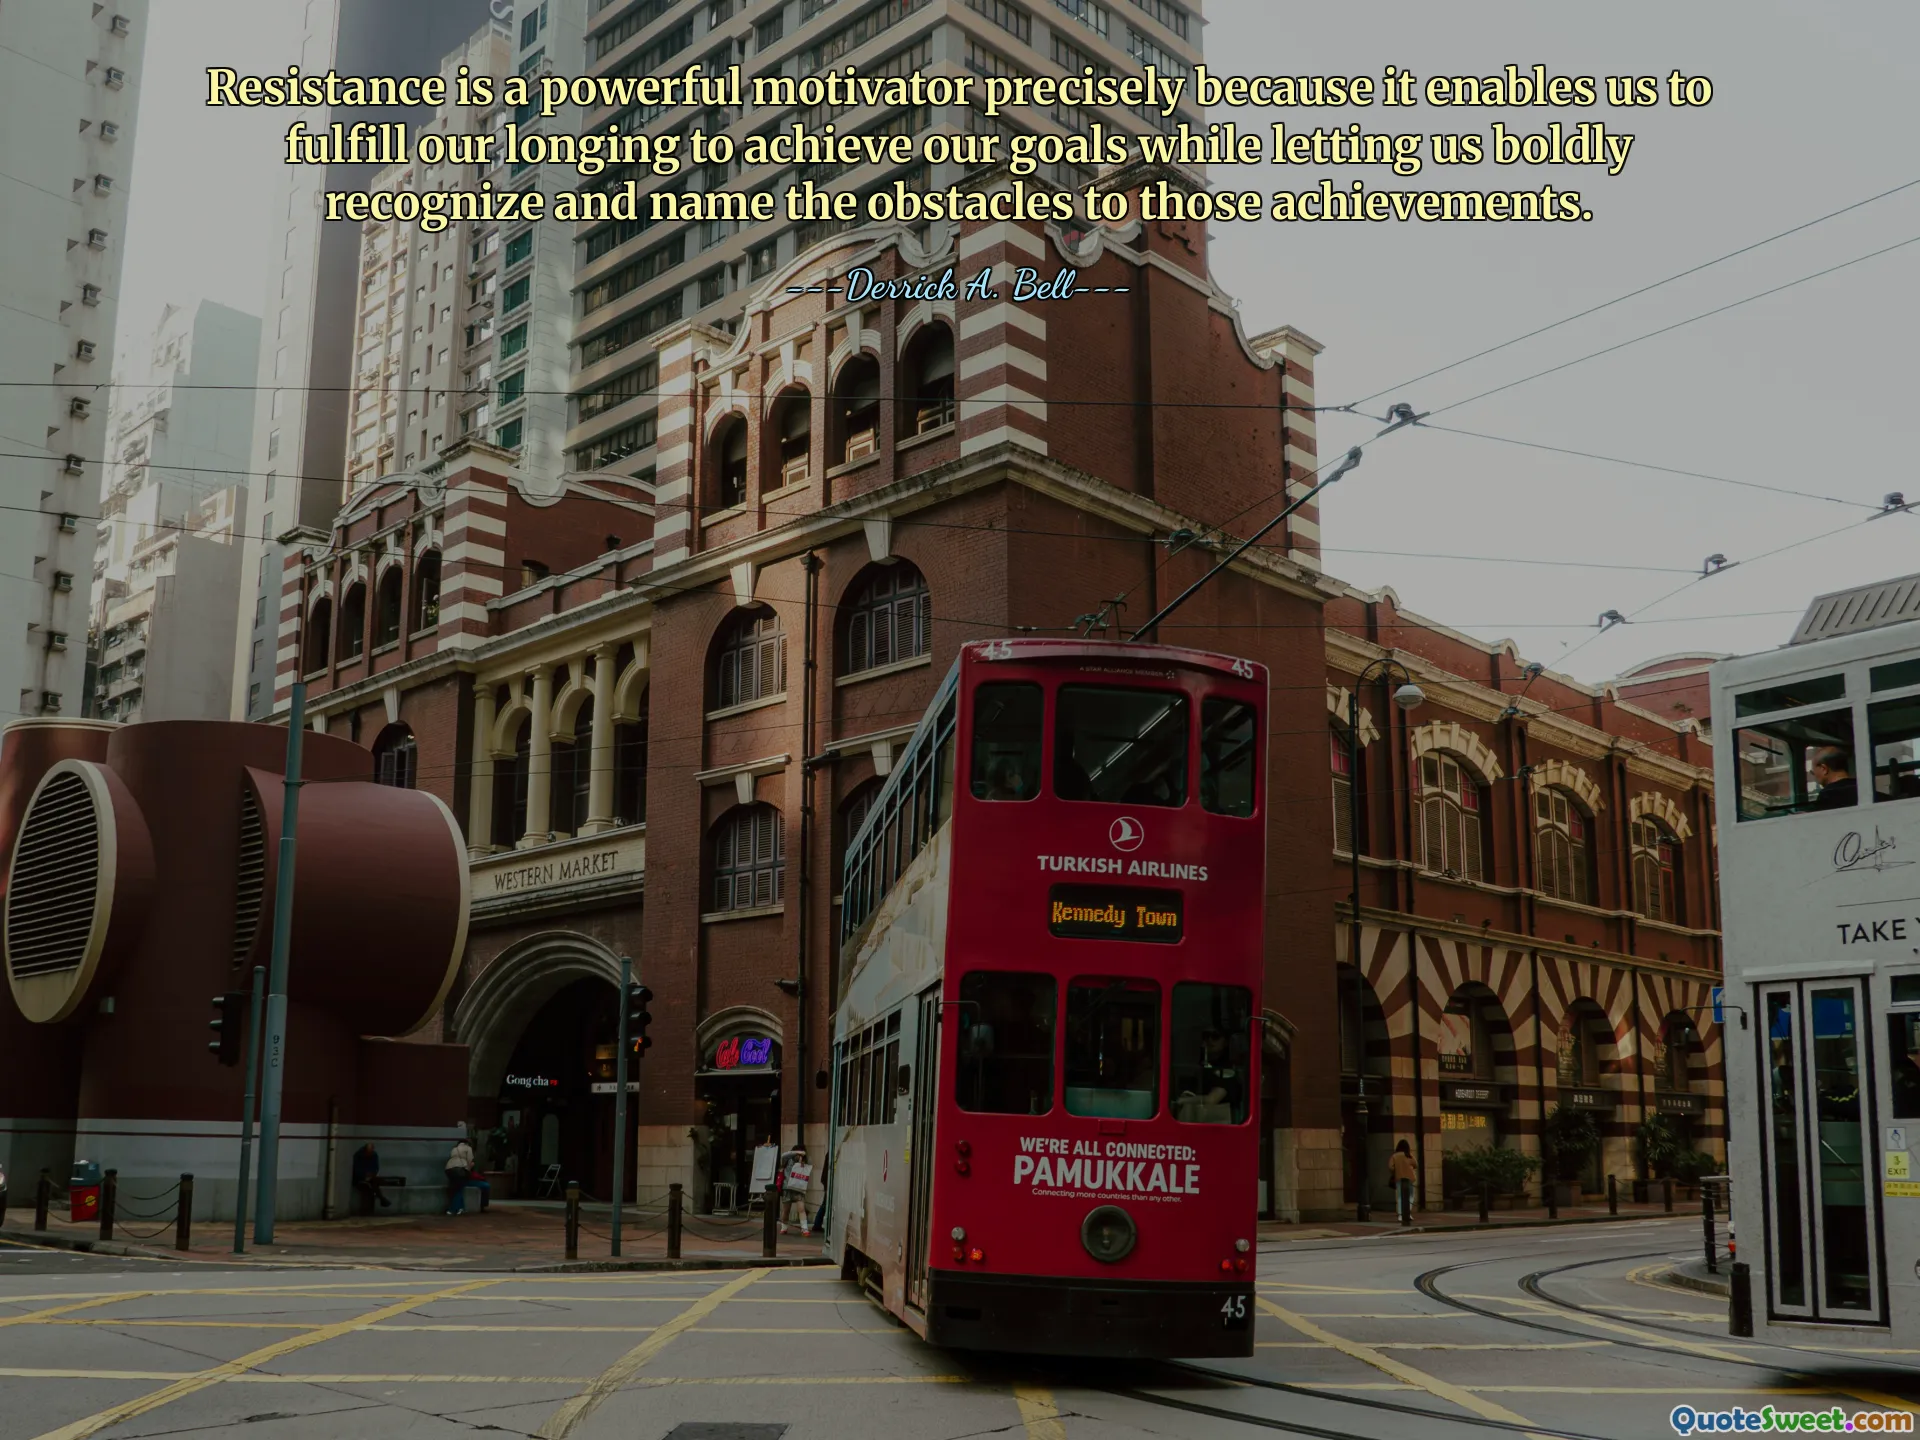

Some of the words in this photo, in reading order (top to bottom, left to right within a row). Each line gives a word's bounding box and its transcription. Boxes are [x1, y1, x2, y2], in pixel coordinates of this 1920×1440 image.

[980, 640, 1013, 661] 45
[1231, 659, 1254, 679] 45
[494, 863, 554, 891] WESTERN
[558, 850, 619, 881] MARKET
[1037, 855, 1122, 874] TURKISH
[1128, 861, 1208, 881] AIRLINES
[1051, 901, 1126, 928] Kennedy
[1136, 906, 1178, 928] Town
[1836, 918, 1907, 945] TAKE
[740, 1037, 773, 1065] Cool
[506, 1074, 532, 1088] Gong
[533, 1075, 549, 1087] cha
[1020, 1136, 1069, 1155] WE'RE
[1073, 1140, 1101, 1157] ALL
[1106, 1142, 1196, 1161] CONNECTED:
[1013, 1155, 1201, 1194] PAMUKKALE
[1887, 1168, 1907, 1176] EXIT
[1032, 1187, 1075, 1199] Connecting
[1076, 1191, 1096, 1199] more
[1097, 1192, 1130, 1201] countries
[1131, 1194, 1147, 1202] than
[1162, 1195, 1182, 1203] other.
[1221, 1295, 1246, 1319] 45
